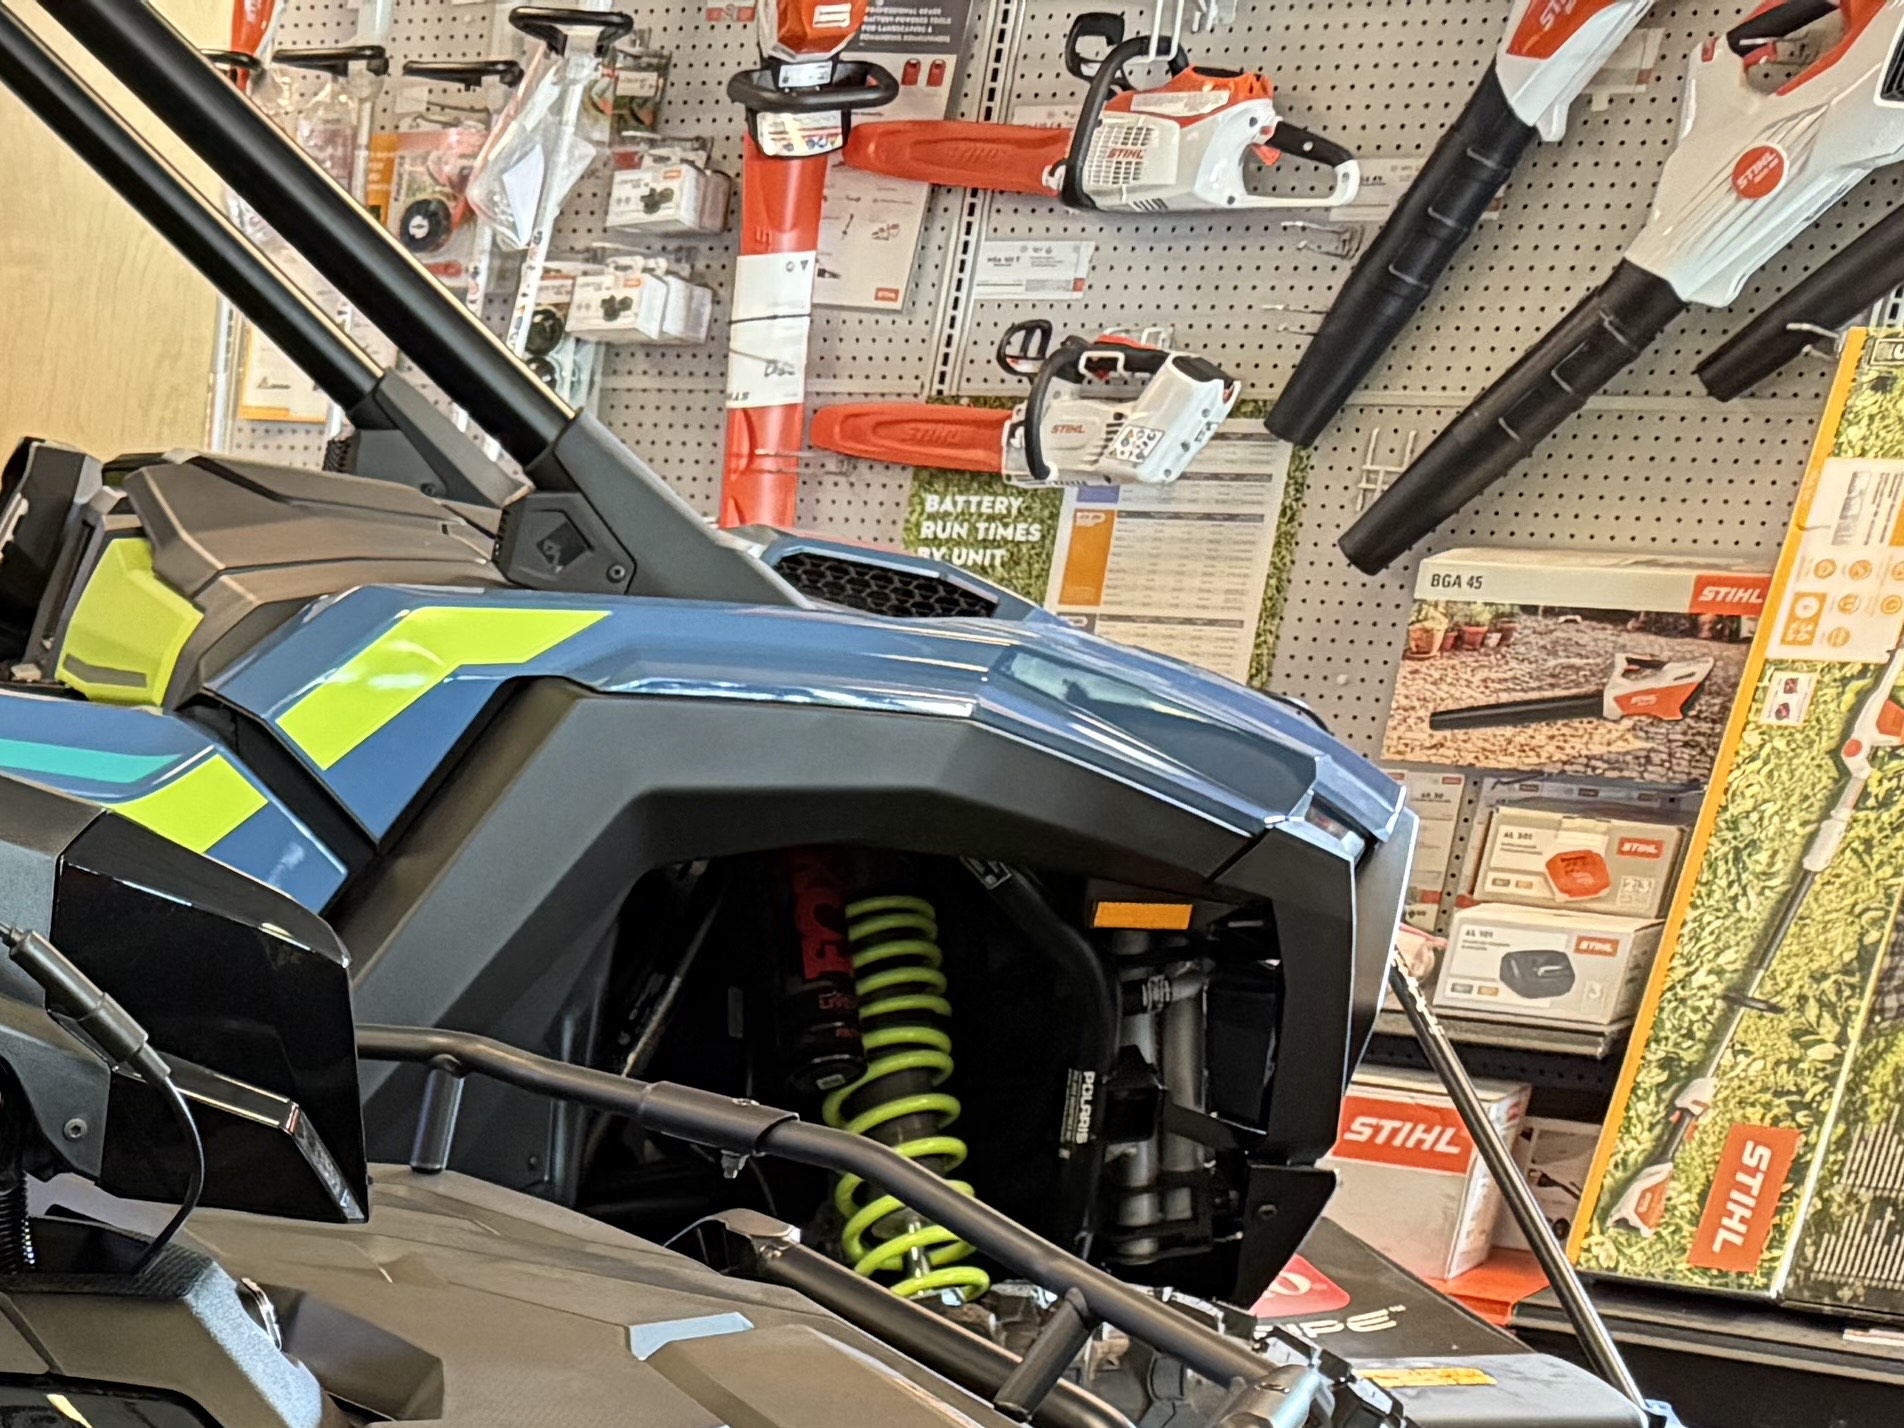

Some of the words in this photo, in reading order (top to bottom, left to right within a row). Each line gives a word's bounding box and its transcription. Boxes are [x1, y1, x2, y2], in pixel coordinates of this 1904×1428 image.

[1737, 151, 1778, 190] STIHL
[924, 494, 1024, 515] BATTERY
[921, 521, 972, 540] RUN
[976, 522, 1042, 542] TIMES
[956, 548, 1007, 567] UNIT
[1430, 573, 1463, 589] BGA
[1466, 575, 1483, 590] 45
[1699, 585, 1763, 604] STIHL
[1076, 1070, 1096, 1145] POLARIS
[1343, 1115, 1462, 1155] STIHL
[1710, 1139, 1772, 1255] STIHL
